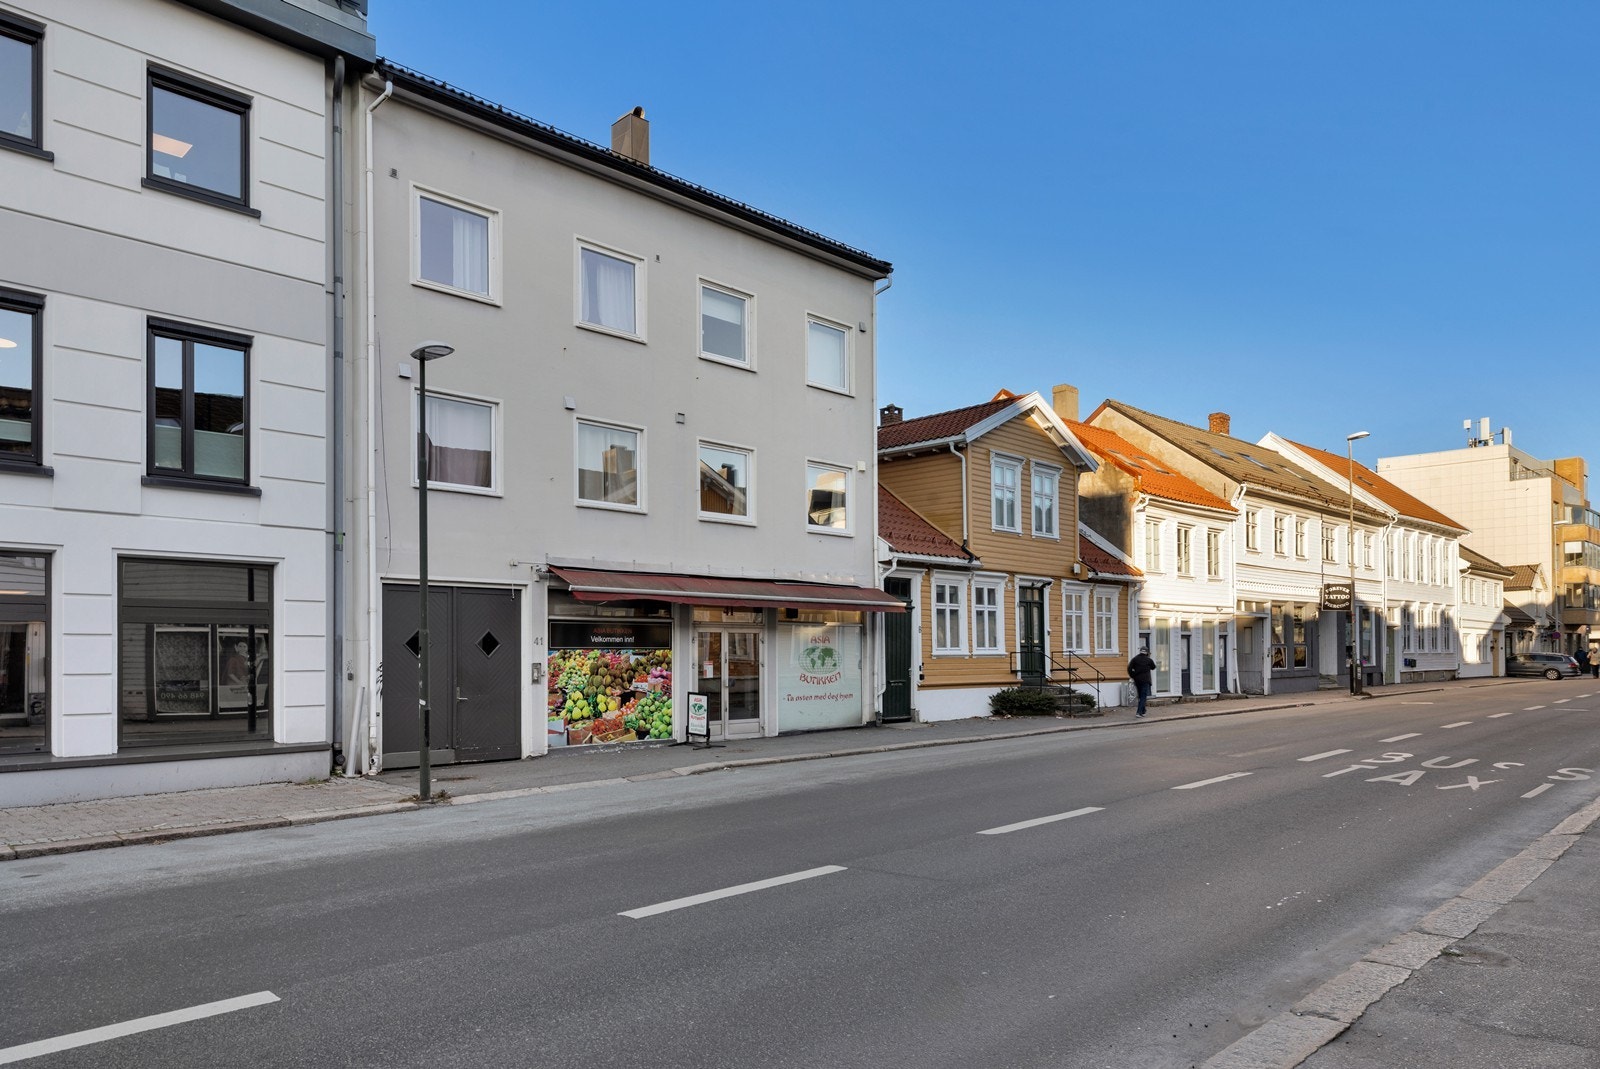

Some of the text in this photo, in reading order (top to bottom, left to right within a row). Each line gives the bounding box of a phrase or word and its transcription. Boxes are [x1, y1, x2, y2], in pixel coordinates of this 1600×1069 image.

[533, 636, 543, 646] 41
[591, 635, 623, 643] Velkommen
[810, 636, 831, 644] ASIA
[814, 692, 827, 701] med
[827, 692, 839, 702] deg
[839, 692, 853, 702] hjem
[1321, 764, 1555, 798] TAXI
